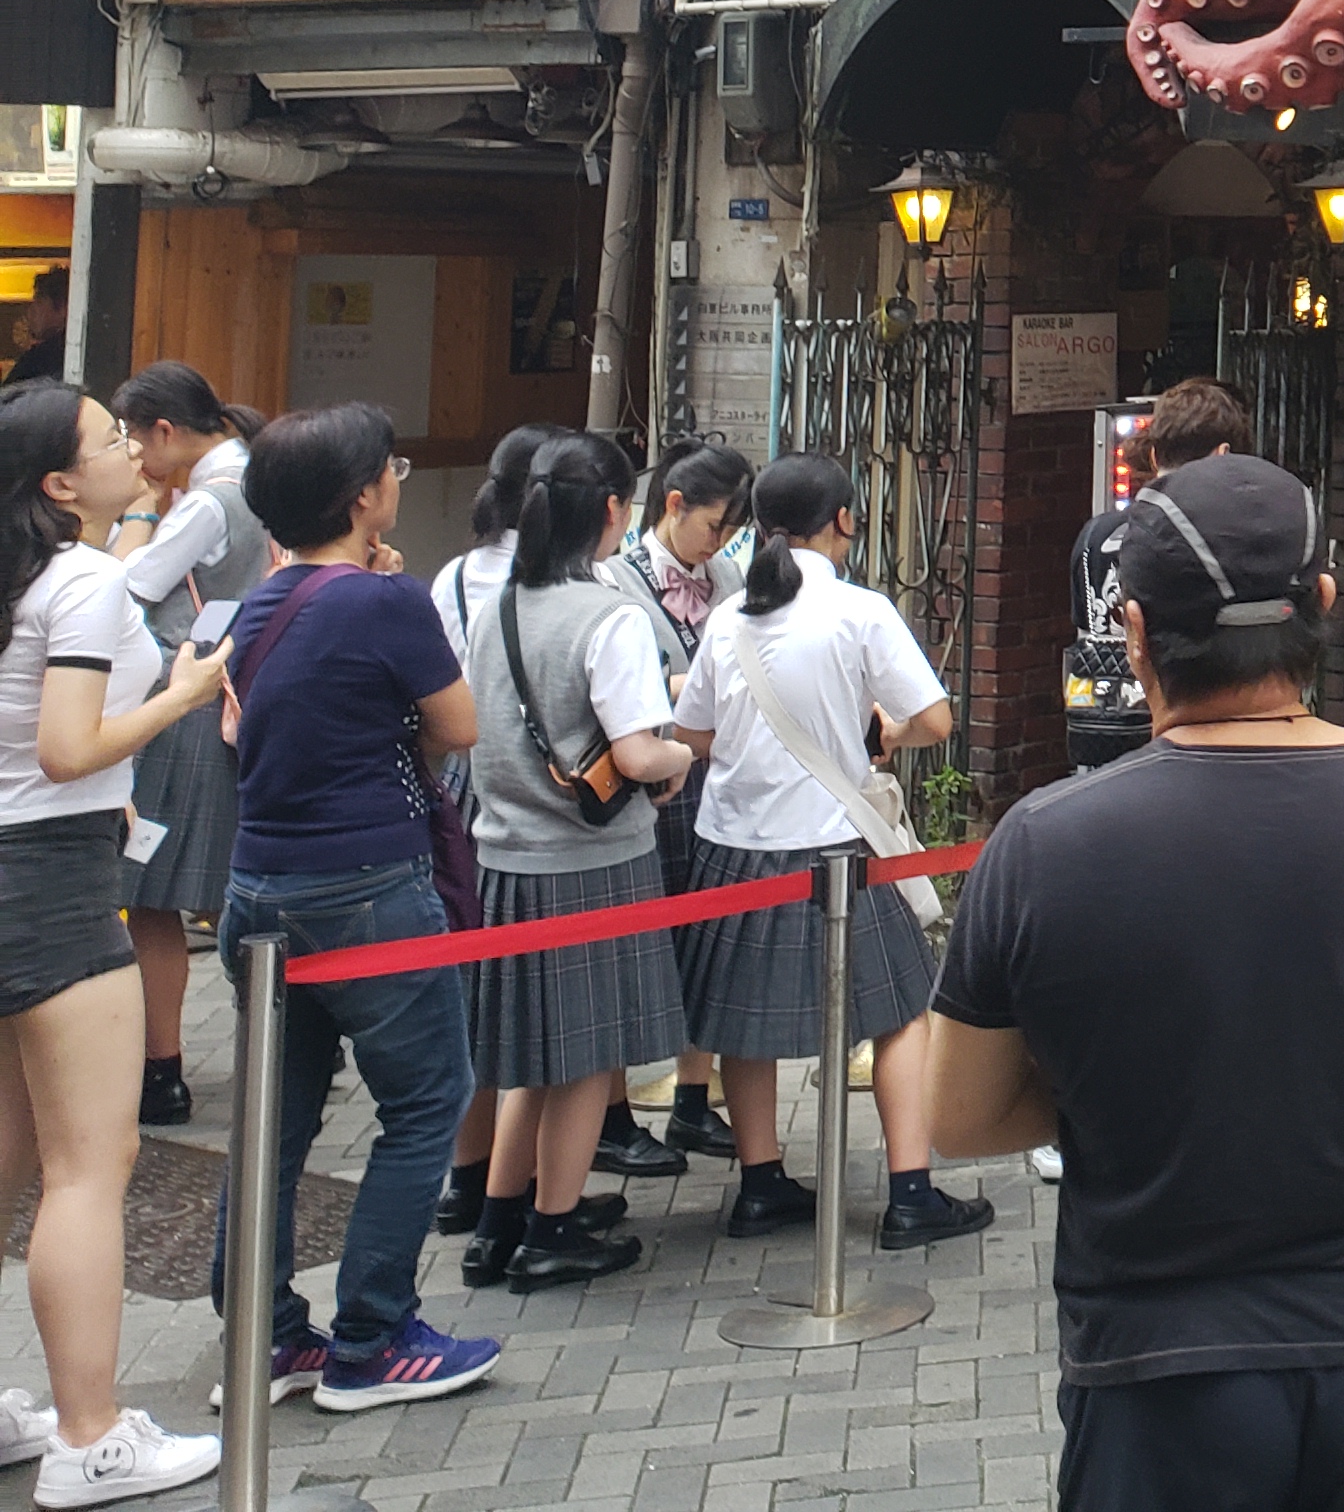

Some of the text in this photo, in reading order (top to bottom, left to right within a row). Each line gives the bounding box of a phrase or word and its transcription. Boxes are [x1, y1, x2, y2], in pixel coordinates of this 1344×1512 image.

[1059, 317, 1073, 328] BAR
[1017, 333, 1115, 354] SALON ARGO
